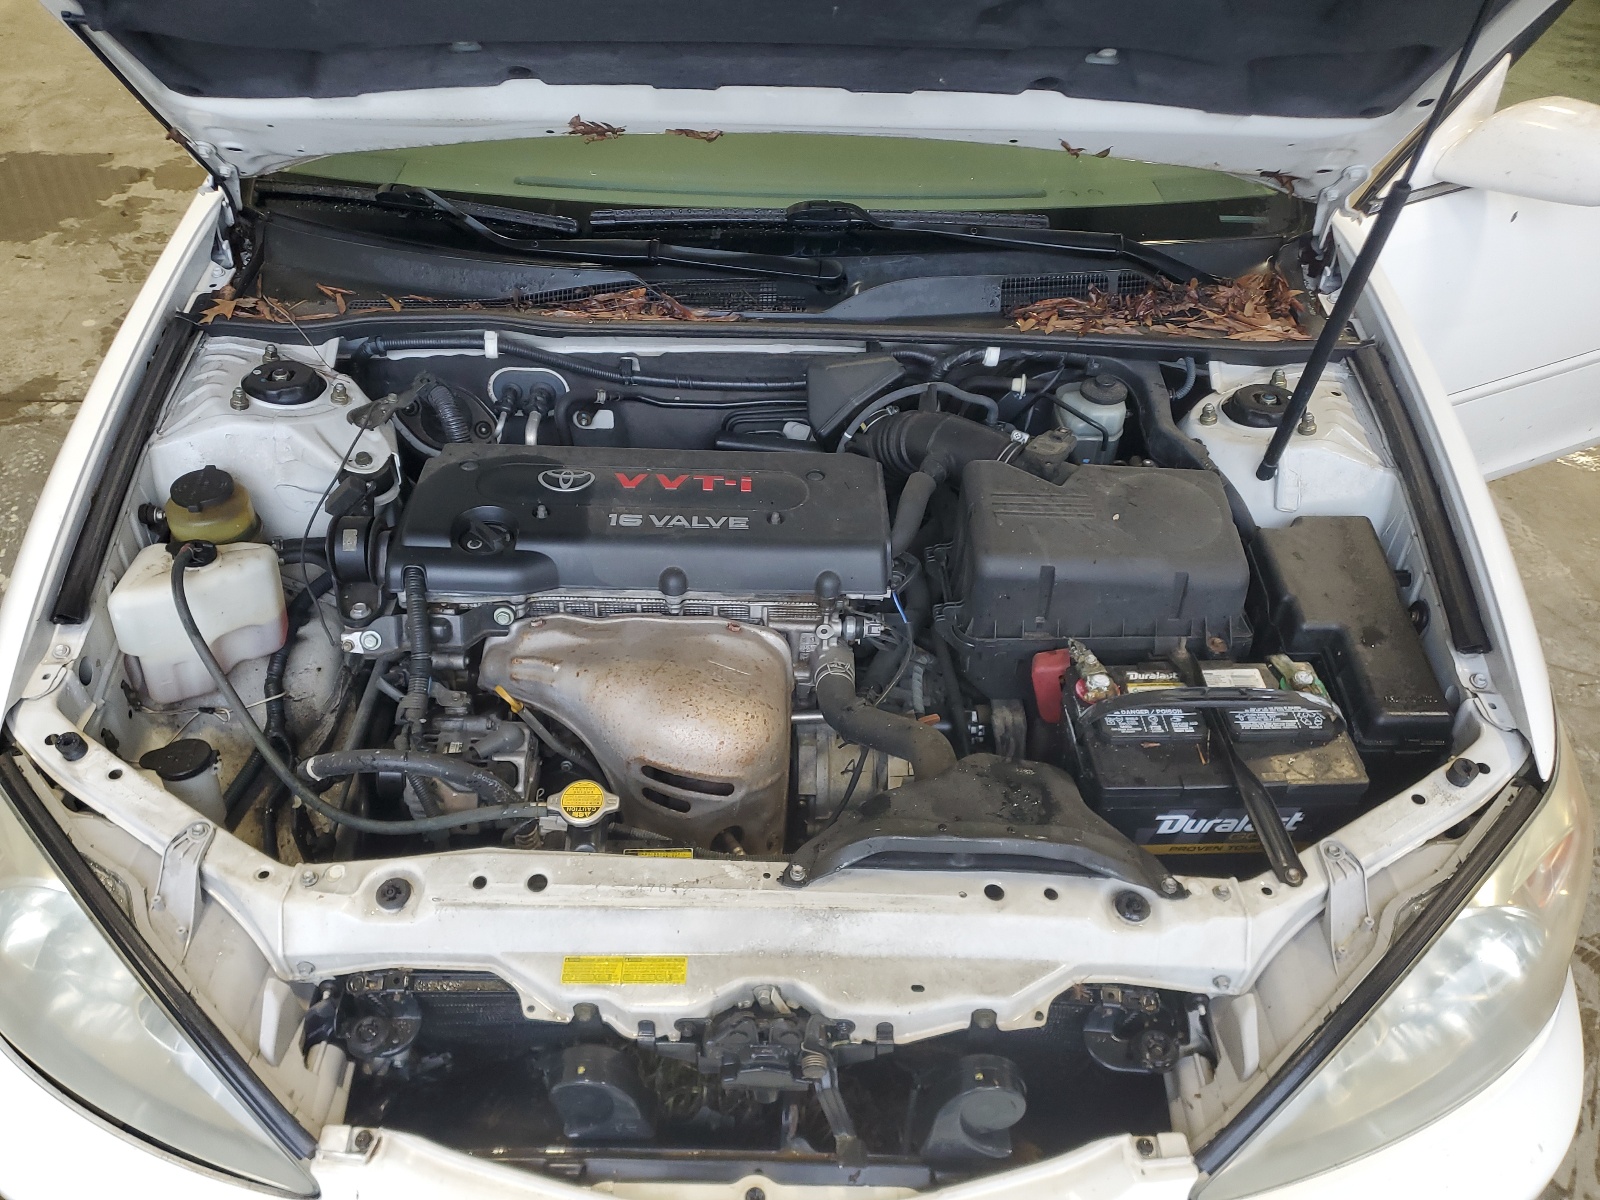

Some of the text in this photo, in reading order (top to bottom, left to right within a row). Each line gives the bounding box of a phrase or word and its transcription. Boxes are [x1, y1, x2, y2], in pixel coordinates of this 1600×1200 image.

[614, 472, 752, 492] VVT-i
[608, 513, 749, 530] 16 VALVE
[1126, 670, 1178, 681] Duralast
[1155, 811, 1305, 835] Duralt
[1228, 844, 1264, 852] TOUG
